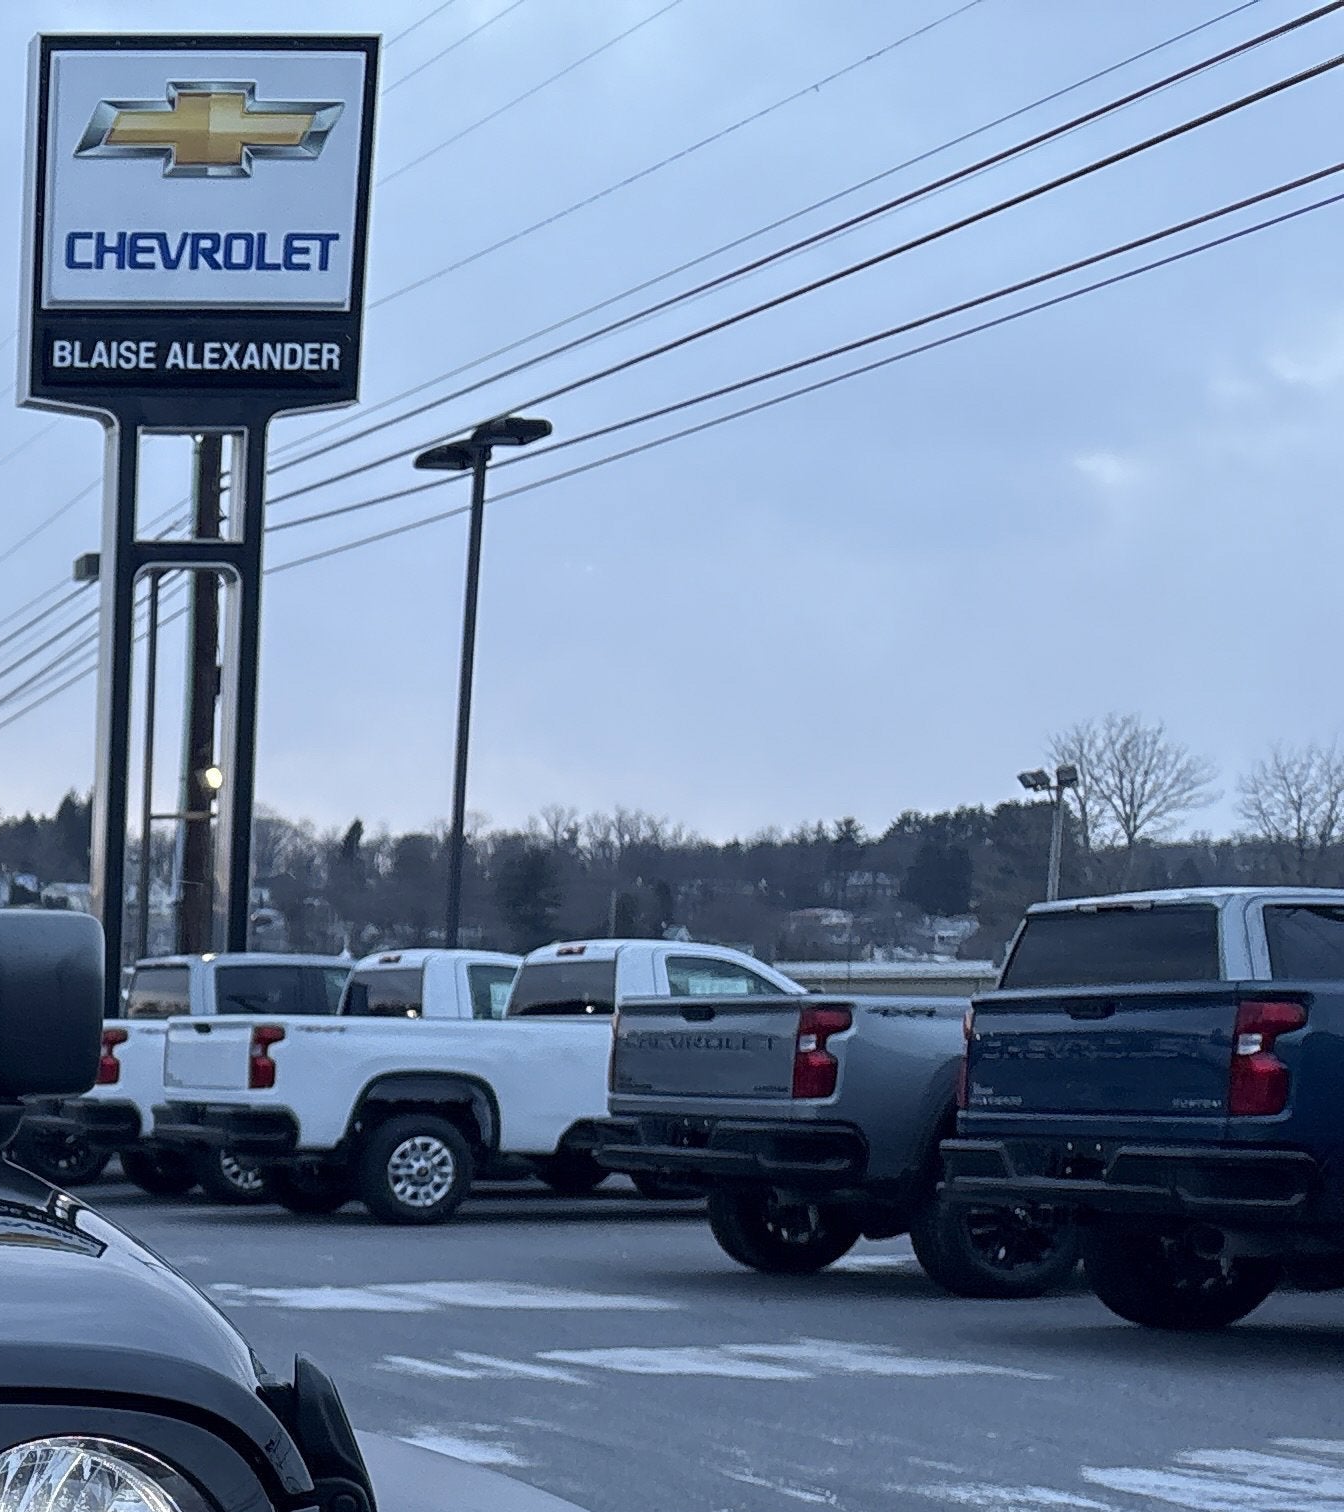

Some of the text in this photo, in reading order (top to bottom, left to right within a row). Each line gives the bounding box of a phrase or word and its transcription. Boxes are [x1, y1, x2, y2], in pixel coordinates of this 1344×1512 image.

[64, 231, 340, 272] CHEVROLET
[52, 340, 341, 371] BLAISE ALEXANDER
